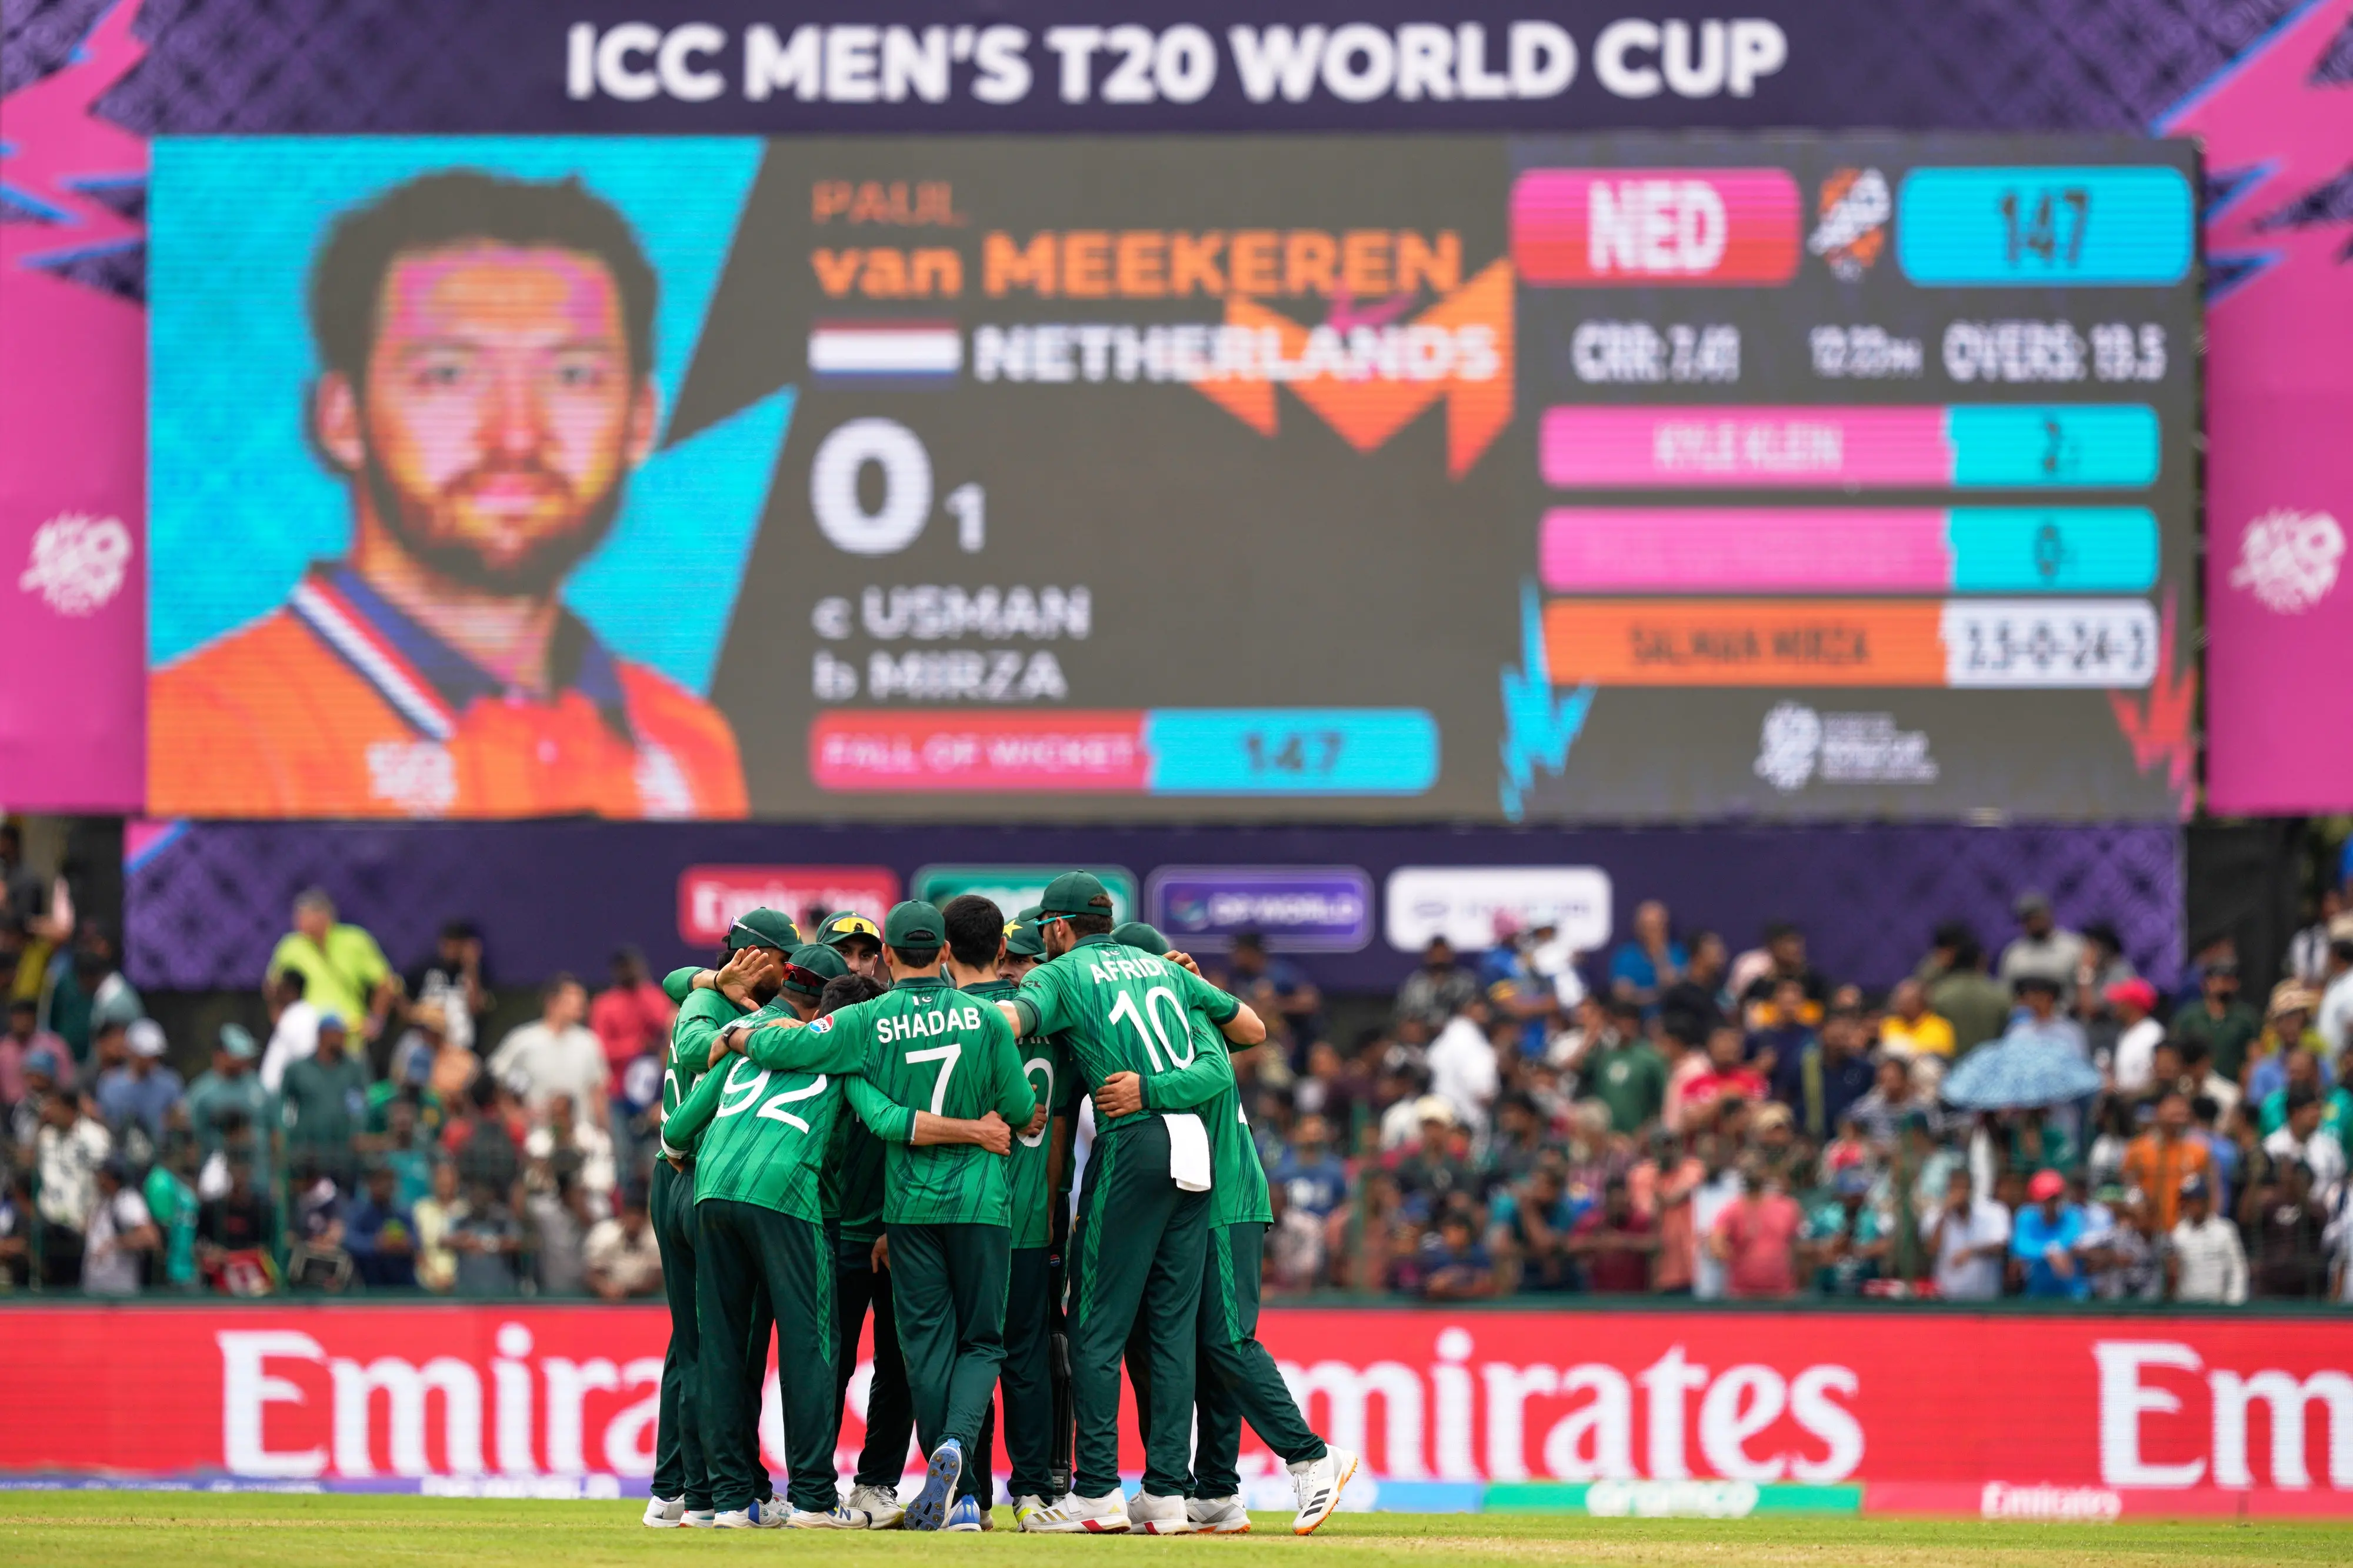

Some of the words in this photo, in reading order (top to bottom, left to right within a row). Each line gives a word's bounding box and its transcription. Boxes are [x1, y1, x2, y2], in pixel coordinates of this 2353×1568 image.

[566, 22, 725, 101] ICC
[742, 24, 1030, 104] MEN'S
[1045, 24, 1219, 105] T20
[1229, 19, 1578, 104] WORLD
[1593, 16, 1787, 99] CUP
[811, 179, 956, 226] PAUL
[1587, 179, 1728, 274] NED
[1998, 187, 2092, 268] 147
[810, 245, 962, 298] van
[982, 228, 1462, 296] MEEKEREN
[974, 323, 1501, 382] NETHERLANDS
[810, 415, 933, 558] 0
[944, 482, 986, 553] 1
[812, 594, 853, 639] c
[861, 585, 1093, 640] USMAN
[814, 650, 858, 700] b
[867, 649, 1068, 700] MIRZA
[821, 732, 920, 773] FALL
[923, 732, 981, 772] OF
[988, 732, 1134, 773] WICKET
[1243, 729, 1344, 775] 147
[1089, 958, 1169, 985] AFRIDI
[876, 1007, 981, 1043] SHADAB
[1108, 986, 1195, 1073] 10
[716, 1056, 828, 1135] 92
[905, 1043, 962, 1116] 7
[1235, 1325, 1866, 1485] mirates
[1980, 1479, 2122, 1520] Emirates
